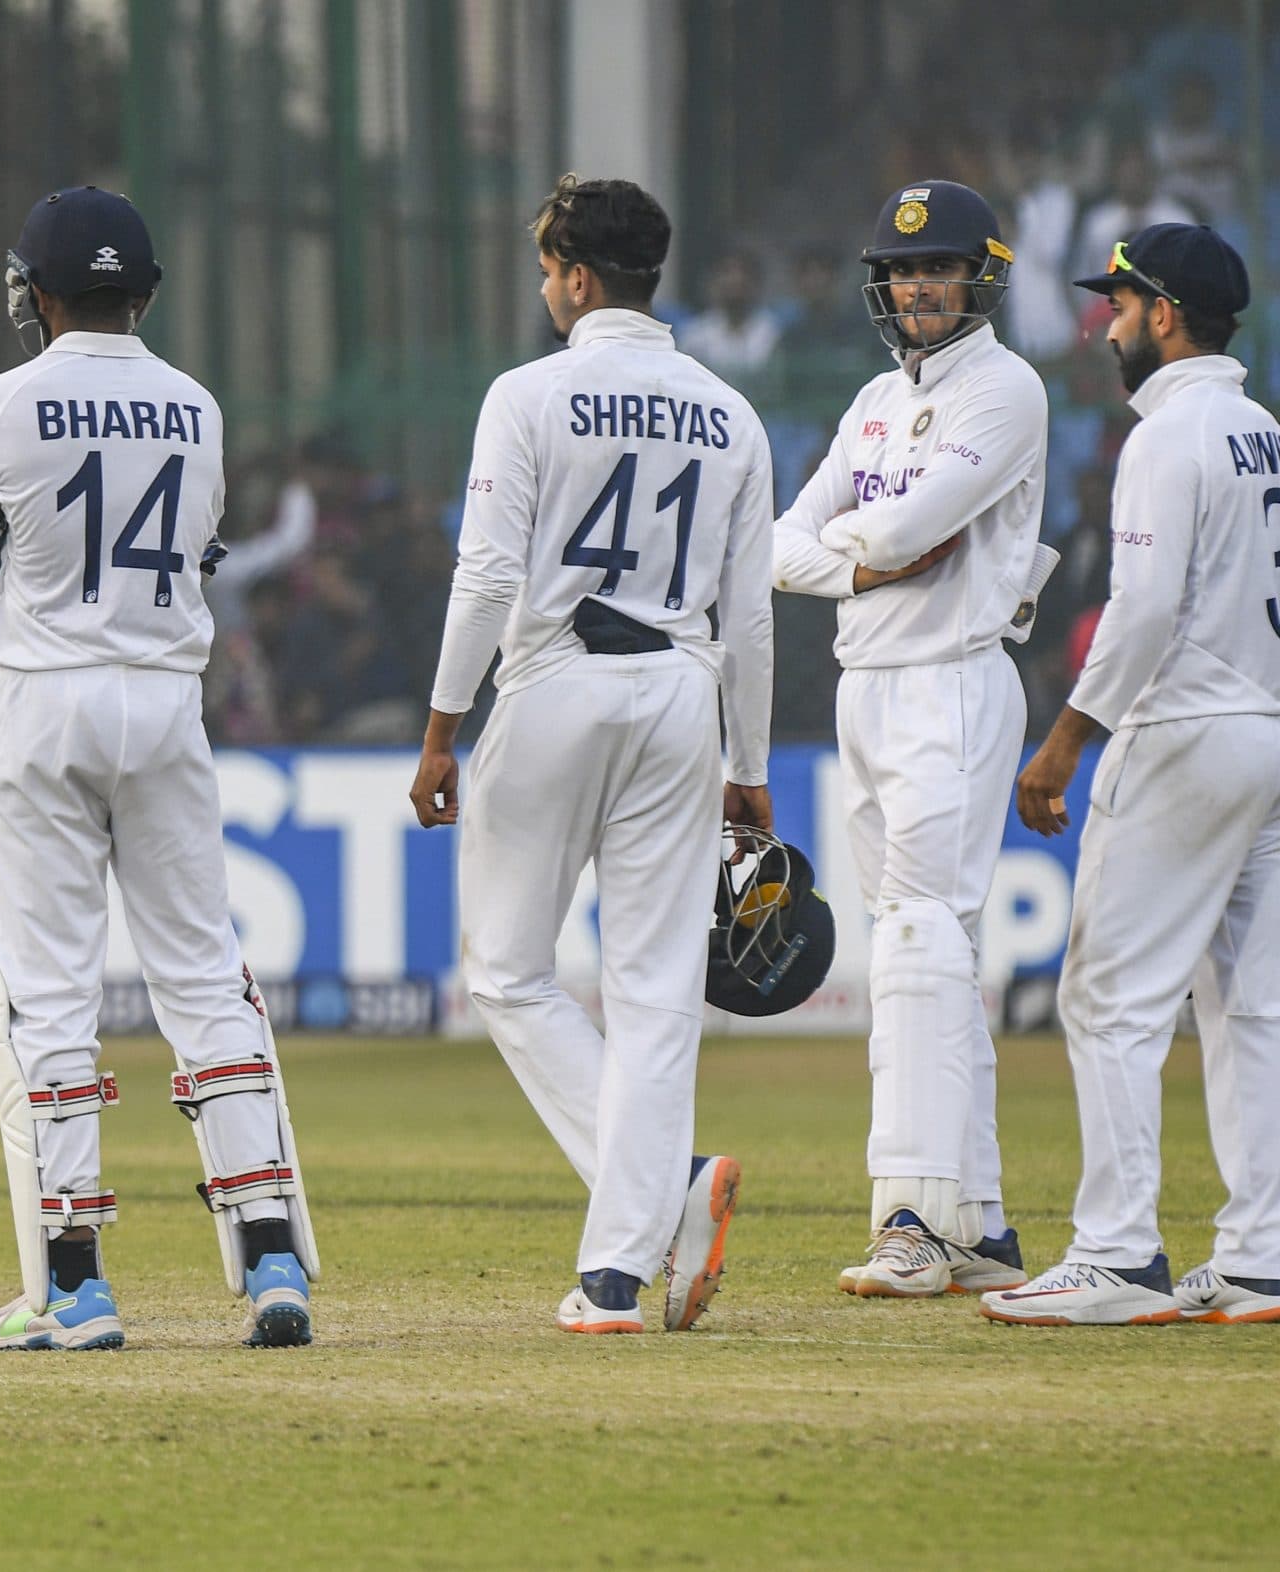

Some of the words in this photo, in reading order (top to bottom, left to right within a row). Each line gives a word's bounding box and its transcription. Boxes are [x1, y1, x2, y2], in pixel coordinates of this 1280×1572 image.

[90, 262, 124, 272] SHREY
[36, 399, 202, 445] BHARAT
[570, 393, 730, 450] SHREYAS
[1227, 431, 1280, 477] AJIN
[56, 450, 186, 608] 14
[561, 452, 703, 611] 41
